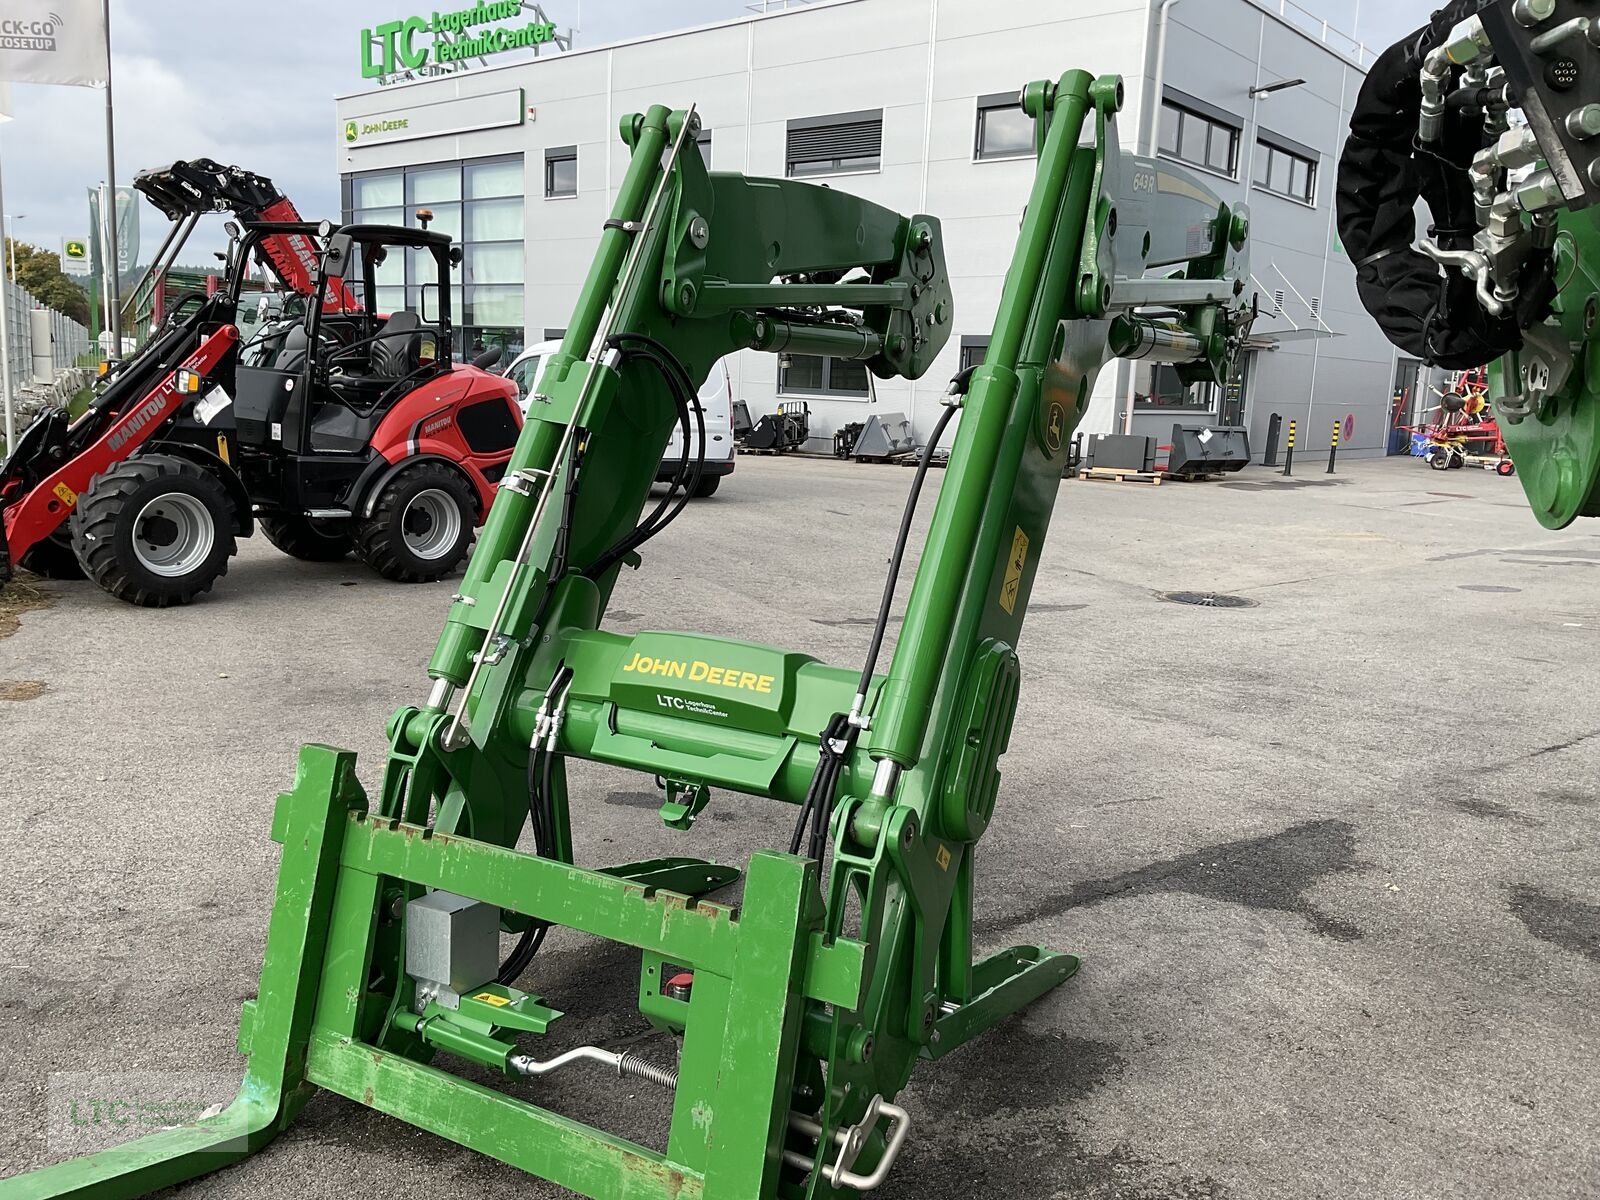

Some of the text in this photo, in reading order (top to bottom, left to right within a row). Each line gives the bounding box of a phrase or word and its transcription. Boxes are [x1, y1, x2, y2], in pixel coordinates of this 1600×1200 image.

[431, 0, 521, 34] Lagerhaus
[0, 20, 55, 36] CK-GO
[361, 16, 430, 78] LTC
[432, 22, 556, 63] TechnikCenter
[361, 119, 409, 135] JOHN DEERE
[1133, 172, 1155, 194] 643R
[161, 374, 176, 395] LT
[106, 394, 168, 452] MANITOU
[425, 416, 451, 433] MANITOU
[623, 653, 775, 694] JOHN DEERE
[656, 694, 684, 709] LTC
[684, 699, 716, 710] Lagerhaus
[686, 705, 729, 718] TechnikCenter
